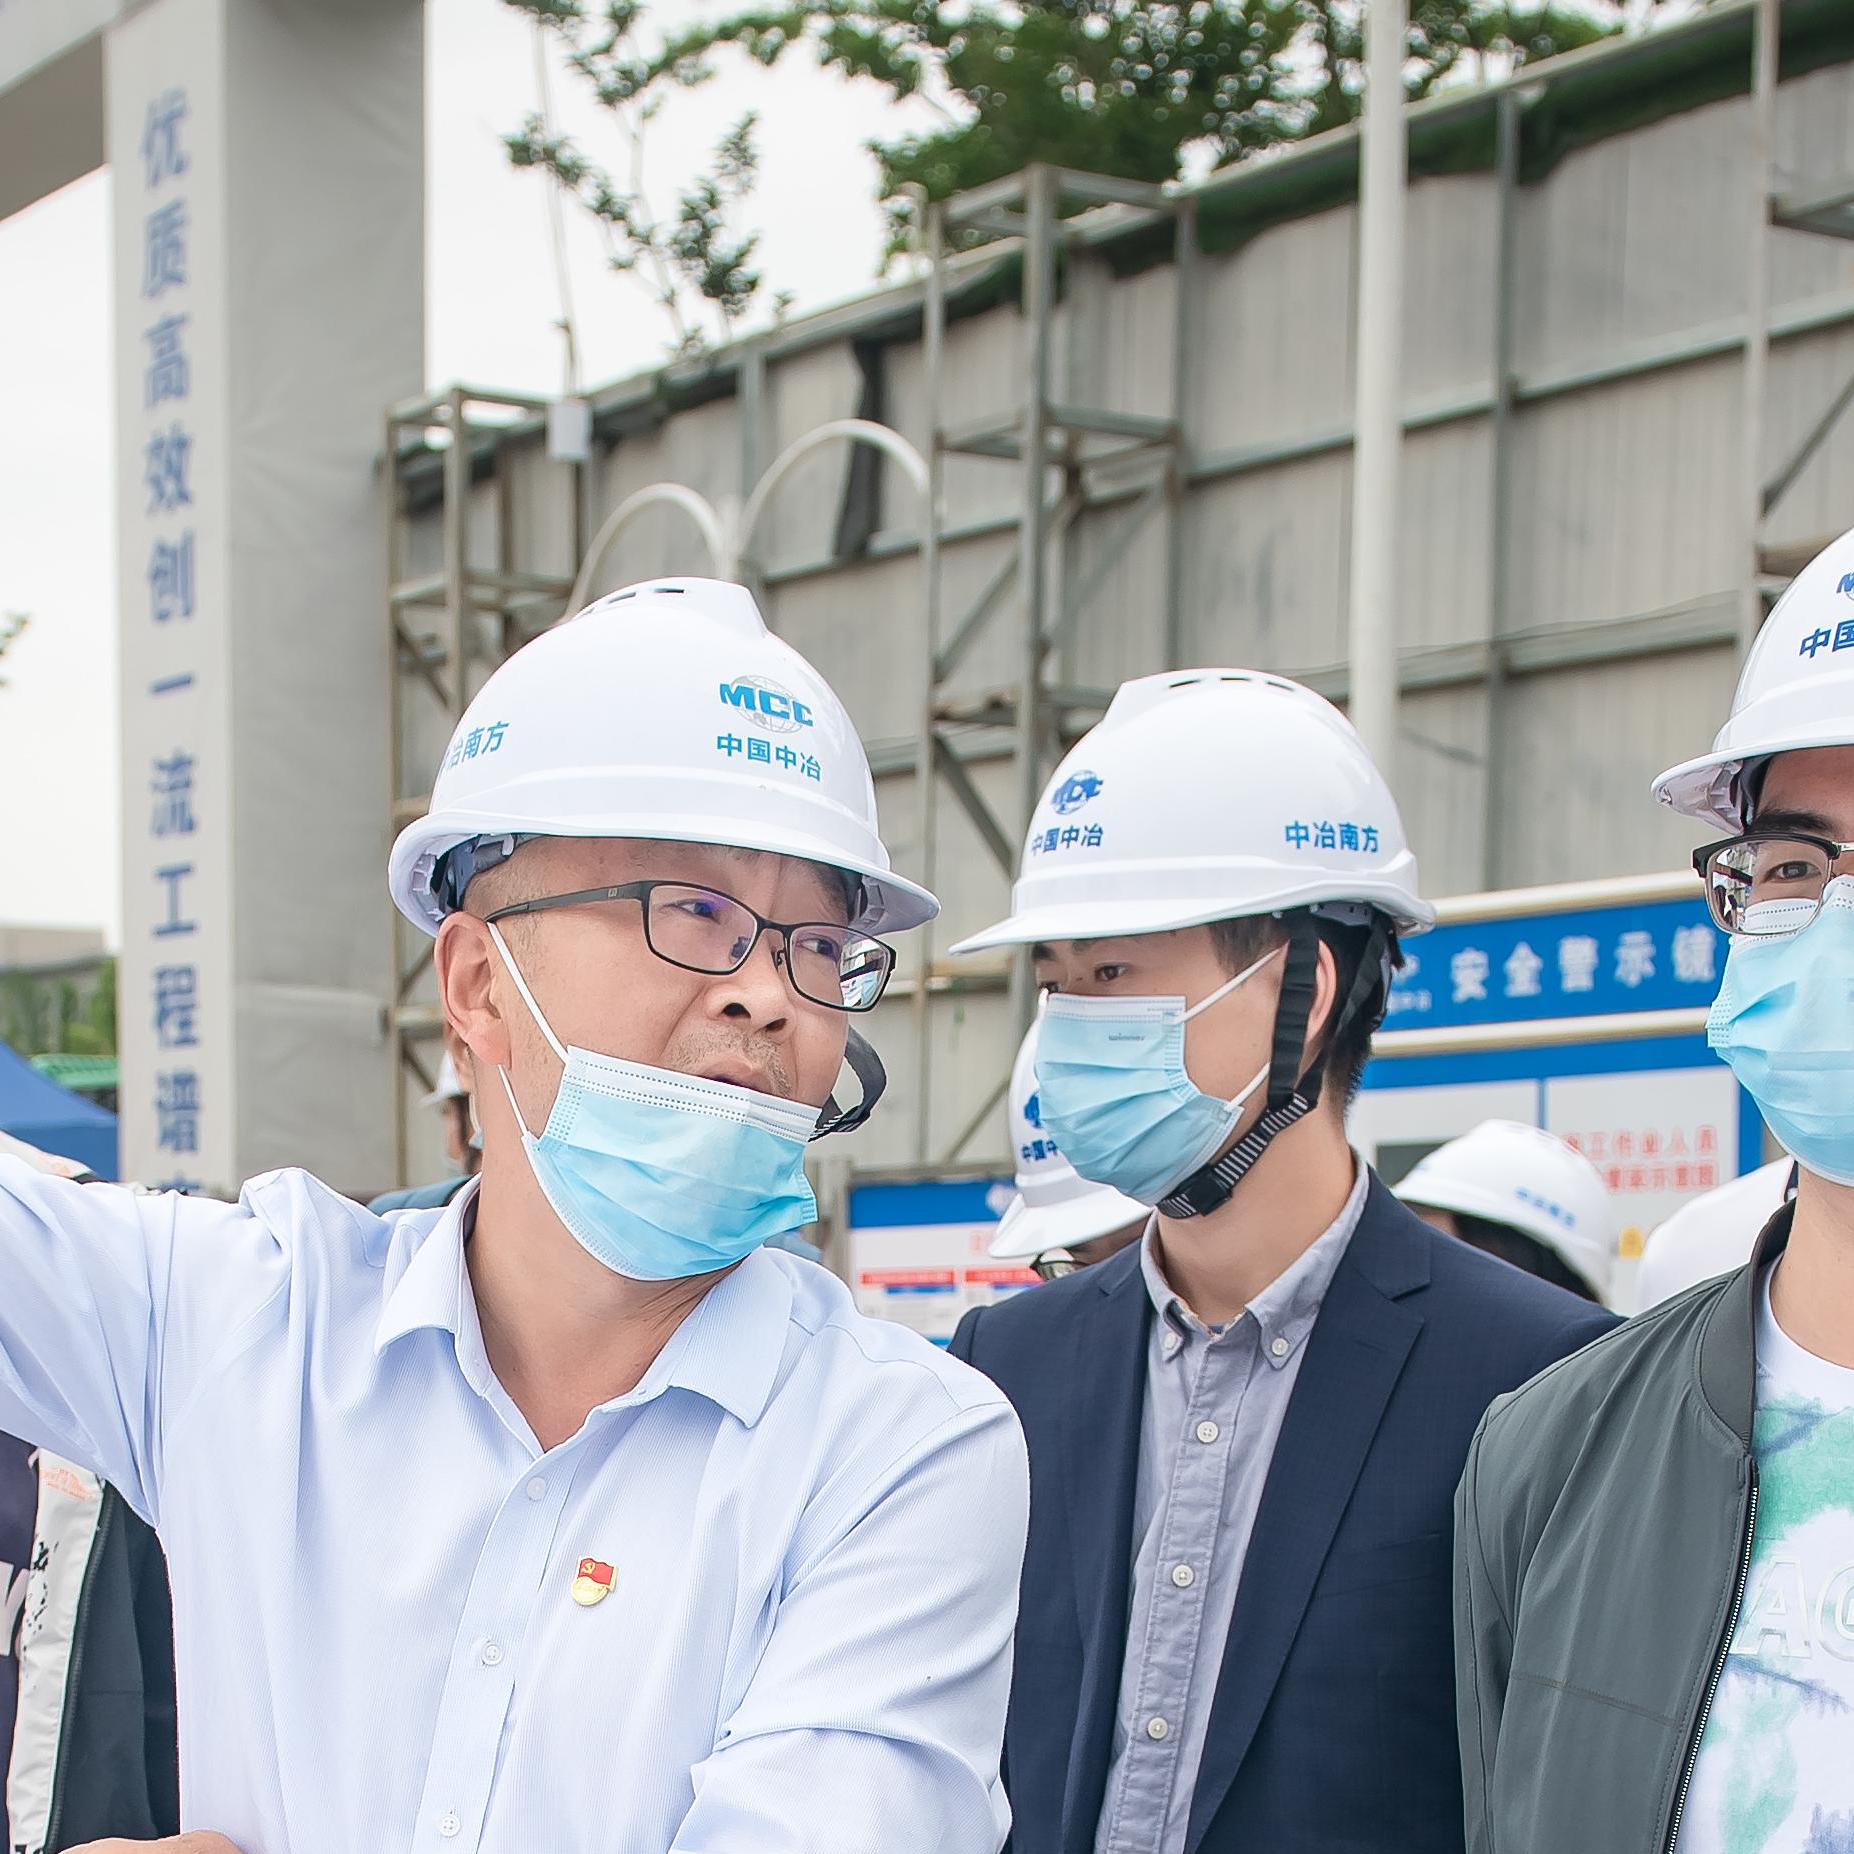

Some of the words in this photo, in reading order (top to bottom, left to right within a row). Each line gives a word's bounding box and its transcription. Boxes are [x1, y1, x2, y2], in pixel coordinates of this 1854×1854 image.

[719, 683, 814, 728] MCC
[716, 732, 822, 782] 中国中冶
[1031, 822, 1105, 857] 中国中冶
[1284, 819, 1380, 854] 中冶南方
